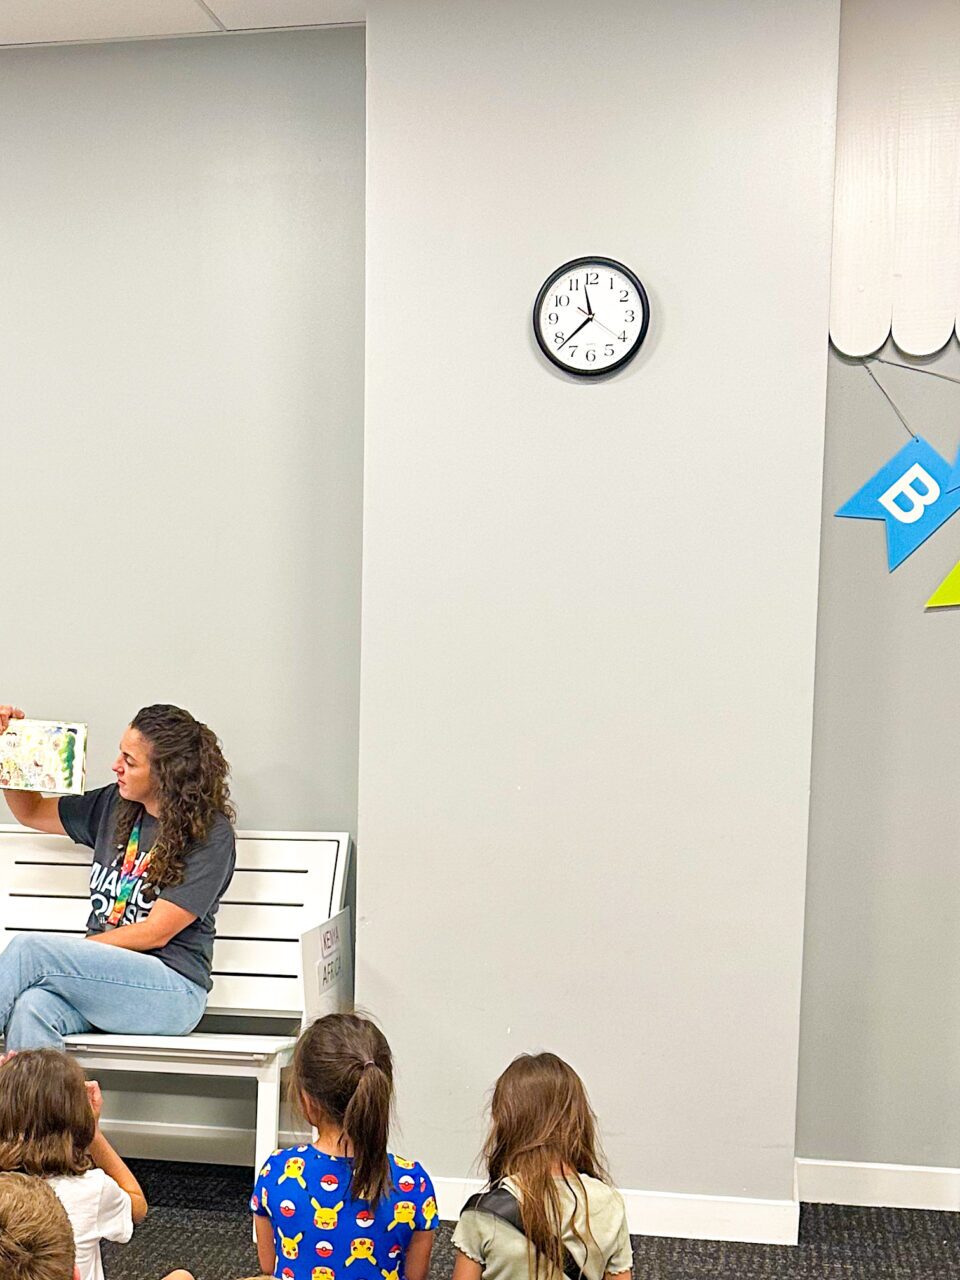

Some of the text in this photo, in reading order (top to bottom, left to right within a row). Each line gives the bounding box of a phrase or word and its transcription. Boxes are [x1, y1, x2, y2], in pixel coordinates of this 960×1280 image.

[569, 278, 579, 291] 11
[586, 273, 599, 285] 12
[555, 295, 570, 307] 10
[619, 290, 629, 303] 2
[548, 313, 559, 325] 9
[625, 310, 635, 323] 3
[554, 331, 565, 344] 8
[617, 330, 628, 342] 4
[569, 345, 578, 357] 7
[585, 349, 596, 362] 6
[604, 344, 614, 356] 5
[877, 462, 941, 524] B
